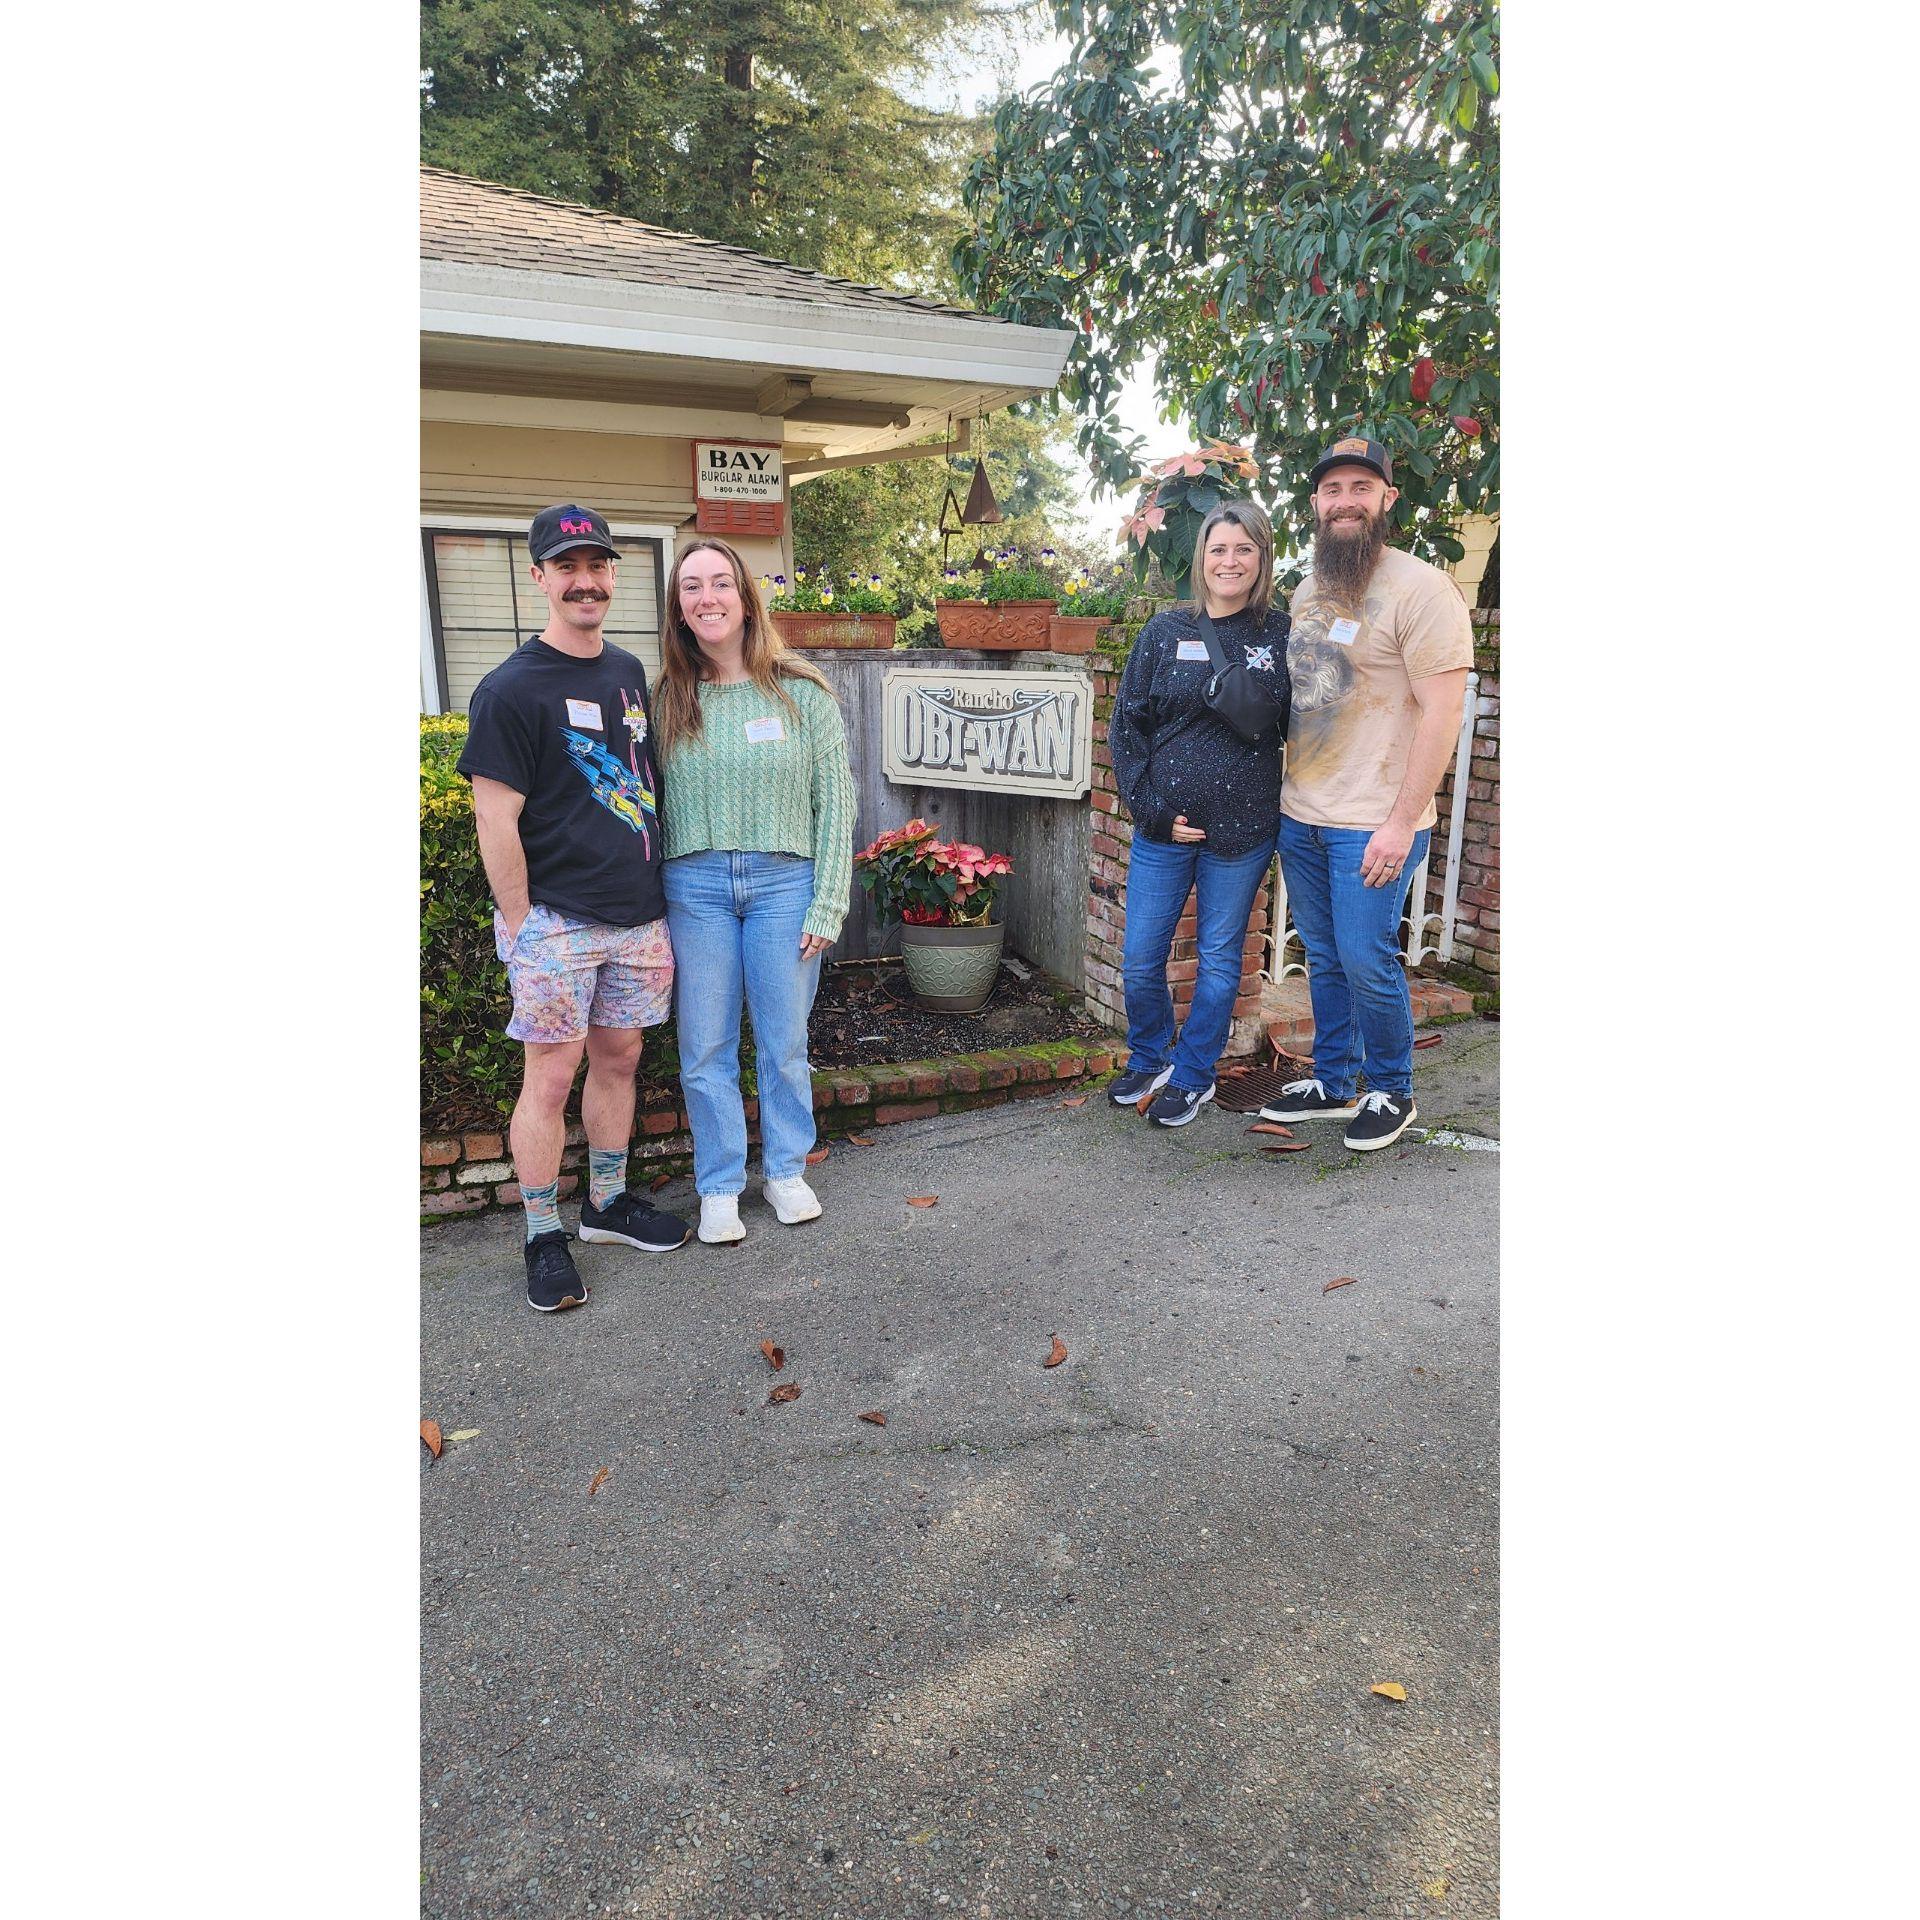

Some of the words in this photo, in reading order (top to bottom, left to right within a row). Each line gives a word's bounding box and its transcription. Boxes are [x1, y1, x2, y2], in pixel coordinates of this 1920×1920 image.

[709, 449, 770, 471] BAY
[701, 470, 743, 483] BURGLAR
[748, 473, 780, 486] ALARM
[953, 685, 1014, 711] Rancho
[894, 684, 1078, 776] OBI-WAN
